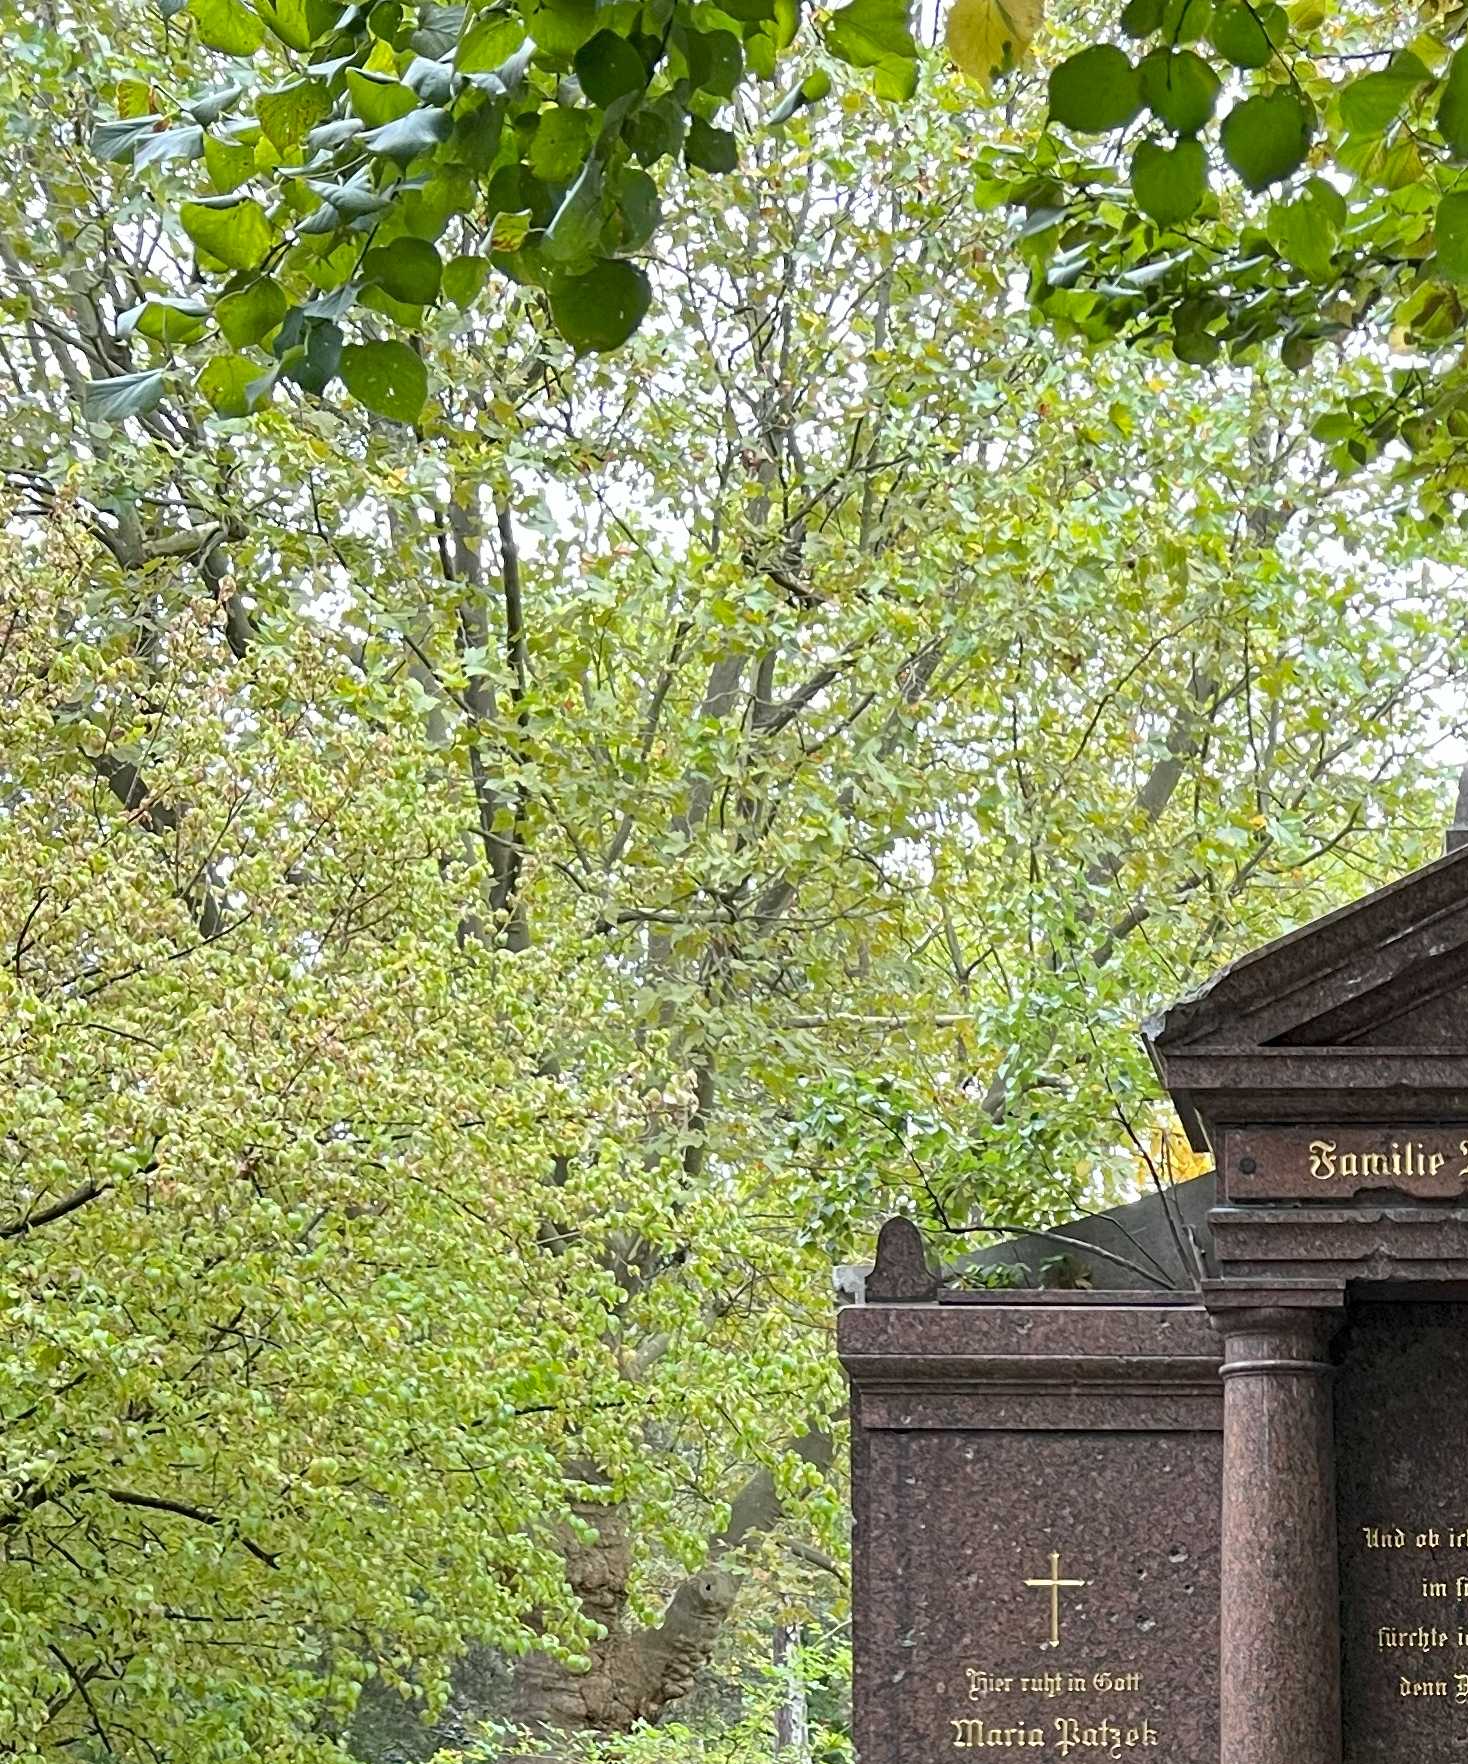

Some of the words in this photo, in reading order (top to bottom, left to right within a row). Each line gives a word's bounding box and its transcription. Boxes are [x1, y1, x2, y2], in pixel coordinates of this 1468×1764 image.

[1309, 1139, 1445, 1181] Familie
[1362, 1526, 1406, 1548] Und
[1415, 1529, 1441, 1548] ob
[1422, 1577, 1447, 1597] im
[1377, 1627, 1448, 1653] fürchte
[966, 1668, 1013, 1701] Hier
[1020, 1672, 1062, 1698] ruht
[1068, 1673, 1086, 1692] in
[1093, 1672, 1142, 1692] Gott
[1399, 1676, 1448, 1697] denn
[950, 1719, 1045, 1747] Maria
[1054, 1717, 1159, 1760] Patzek
